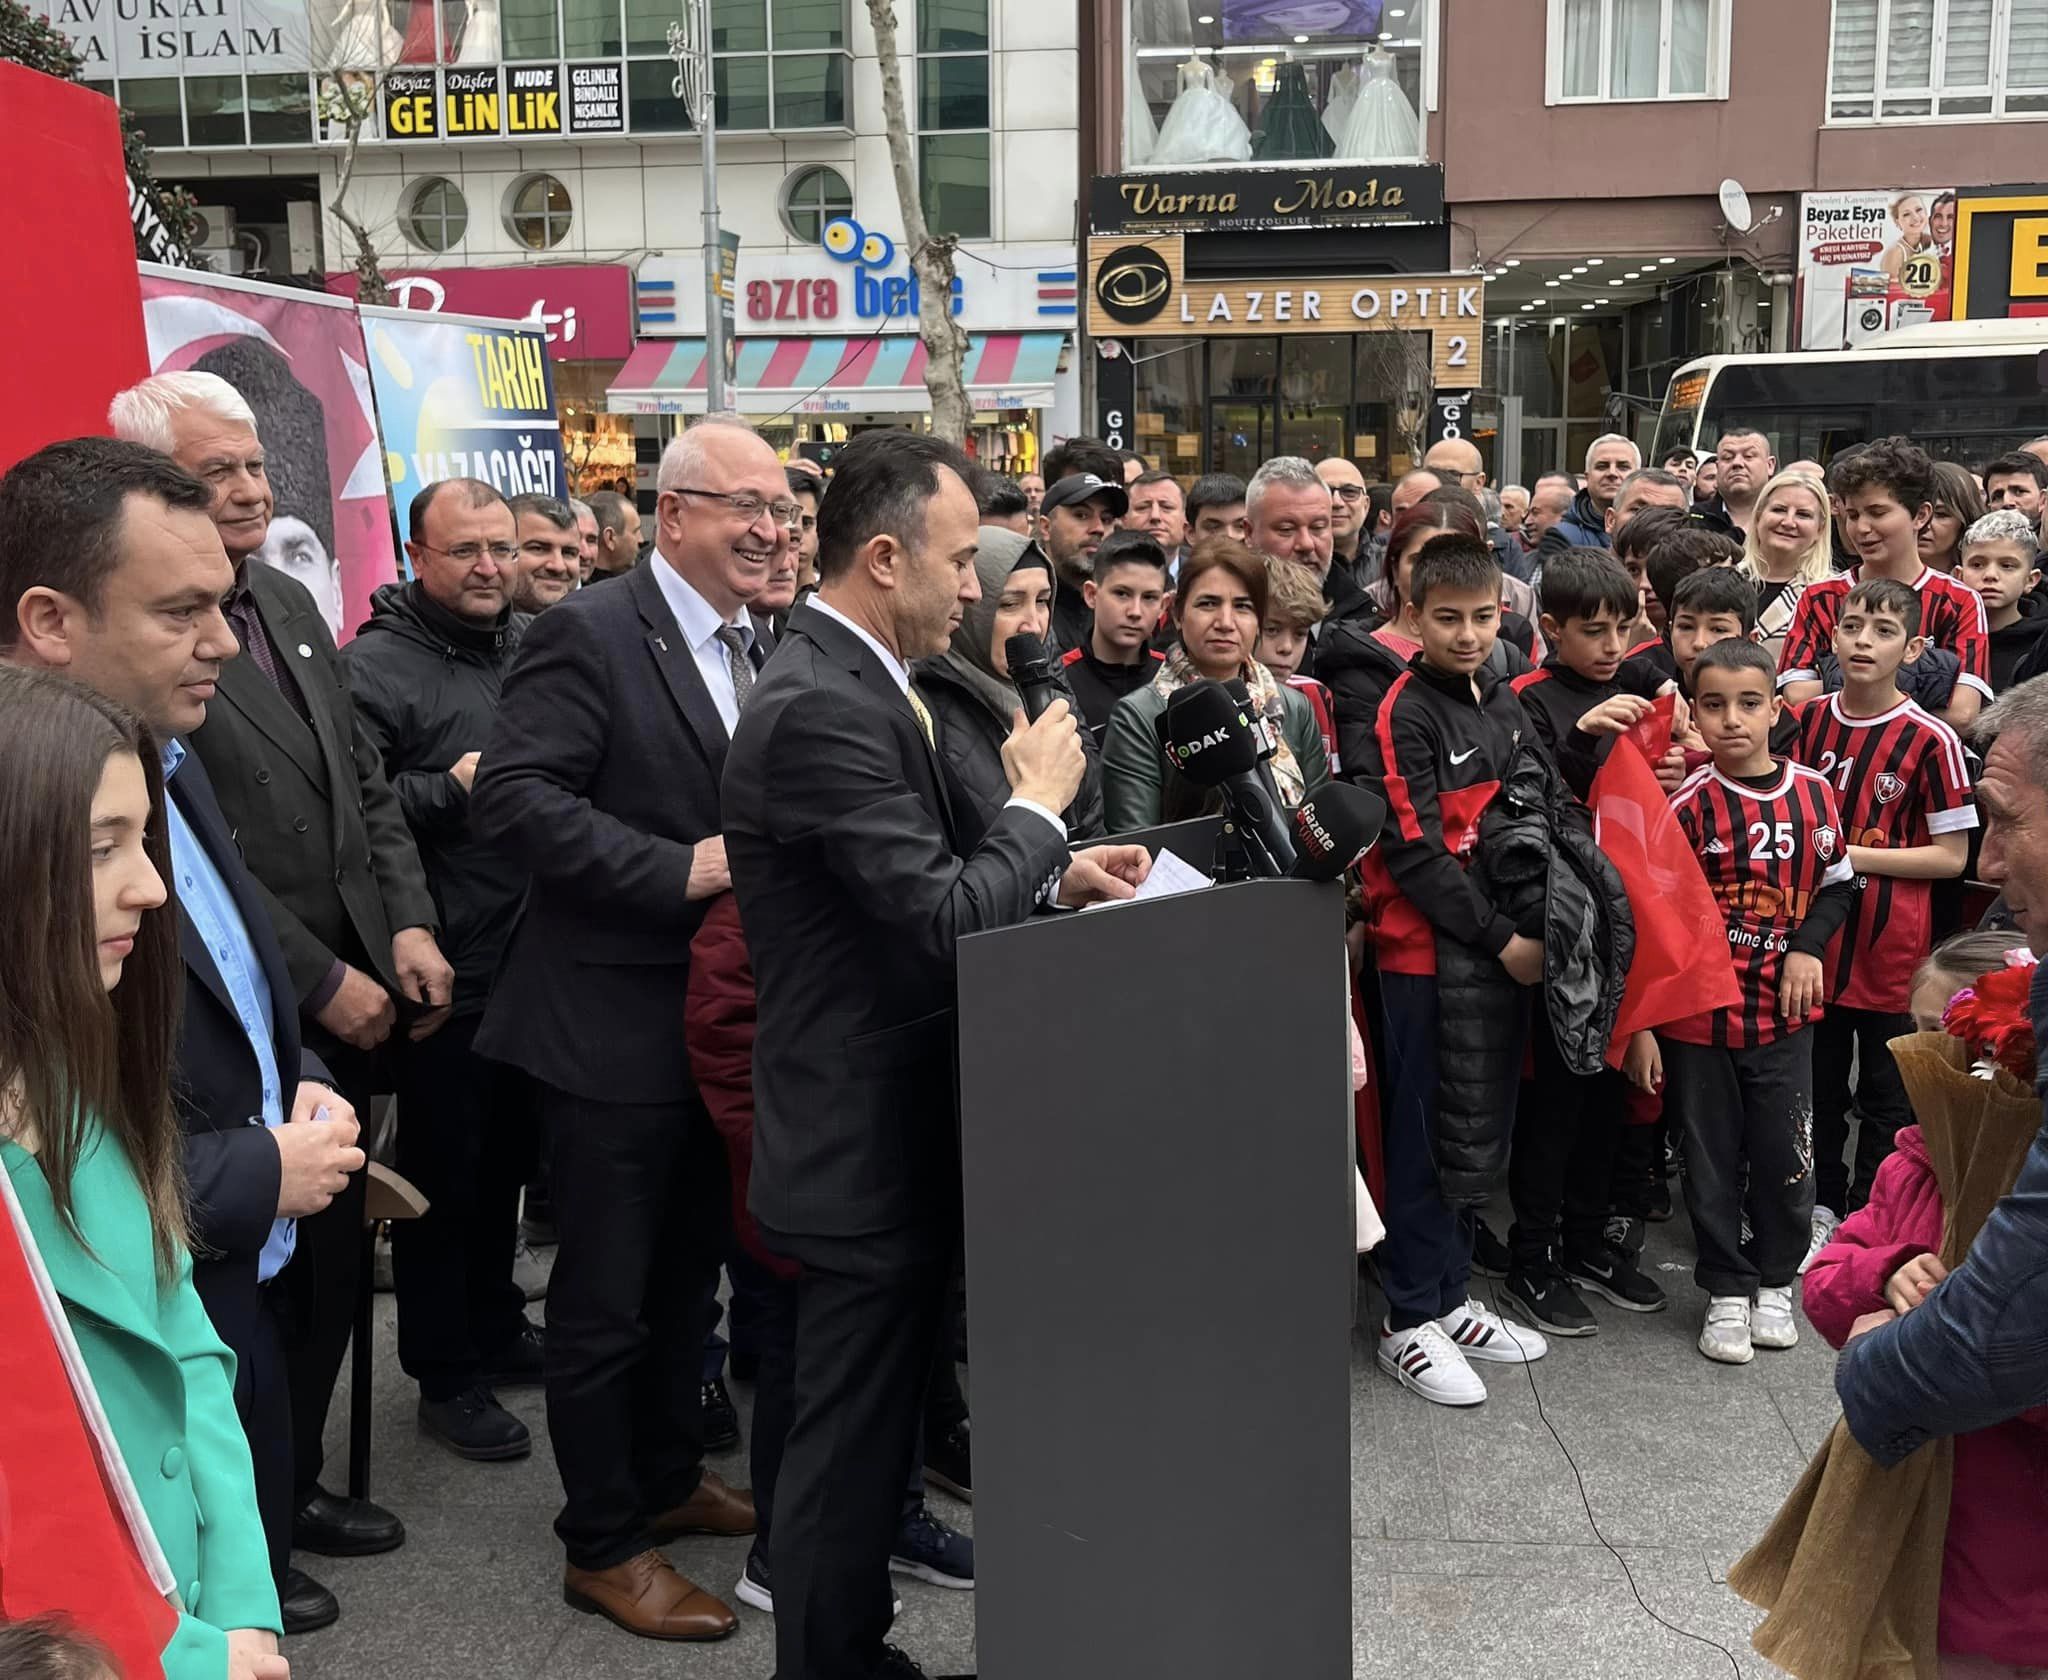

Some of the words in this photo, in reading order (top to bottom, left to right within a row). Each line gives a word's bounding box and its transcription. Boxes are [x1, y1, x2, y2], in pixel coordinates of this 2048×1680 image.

[139, 25, 282, 60] İSLAM
[389, 75, 432, 95] Beyaz
[447, 71, 496, 92] Düşler
[514, 69, 554, 88] NUDE
[1119, 182, 1239, 215] Varna
[1273, 178, 1405, 214] Moda
[1259, 217, 1312, 227] COUTURE
[1806, 207, 1850, 224] Beyaz
[1852, 206, 1886, 223] Eşya
[1806, 223, 1883, 241] Paketleri
[1906, 263, 1931, 283] 20
[746, 278, 839, 321] azra
[1180, 291, 1321, 322] LAZER
[1447, 335, 1468, 367] 2
[465, 330, 548, 410] TARİH
[1820, 750, 1854, 791] 21
[1302, 802, 1336, 852] Gazete
[1749, 822, 1795, 860] 25
[1728, 927, 1761, 949] dine
[1764, 933, 1776, 951] &
